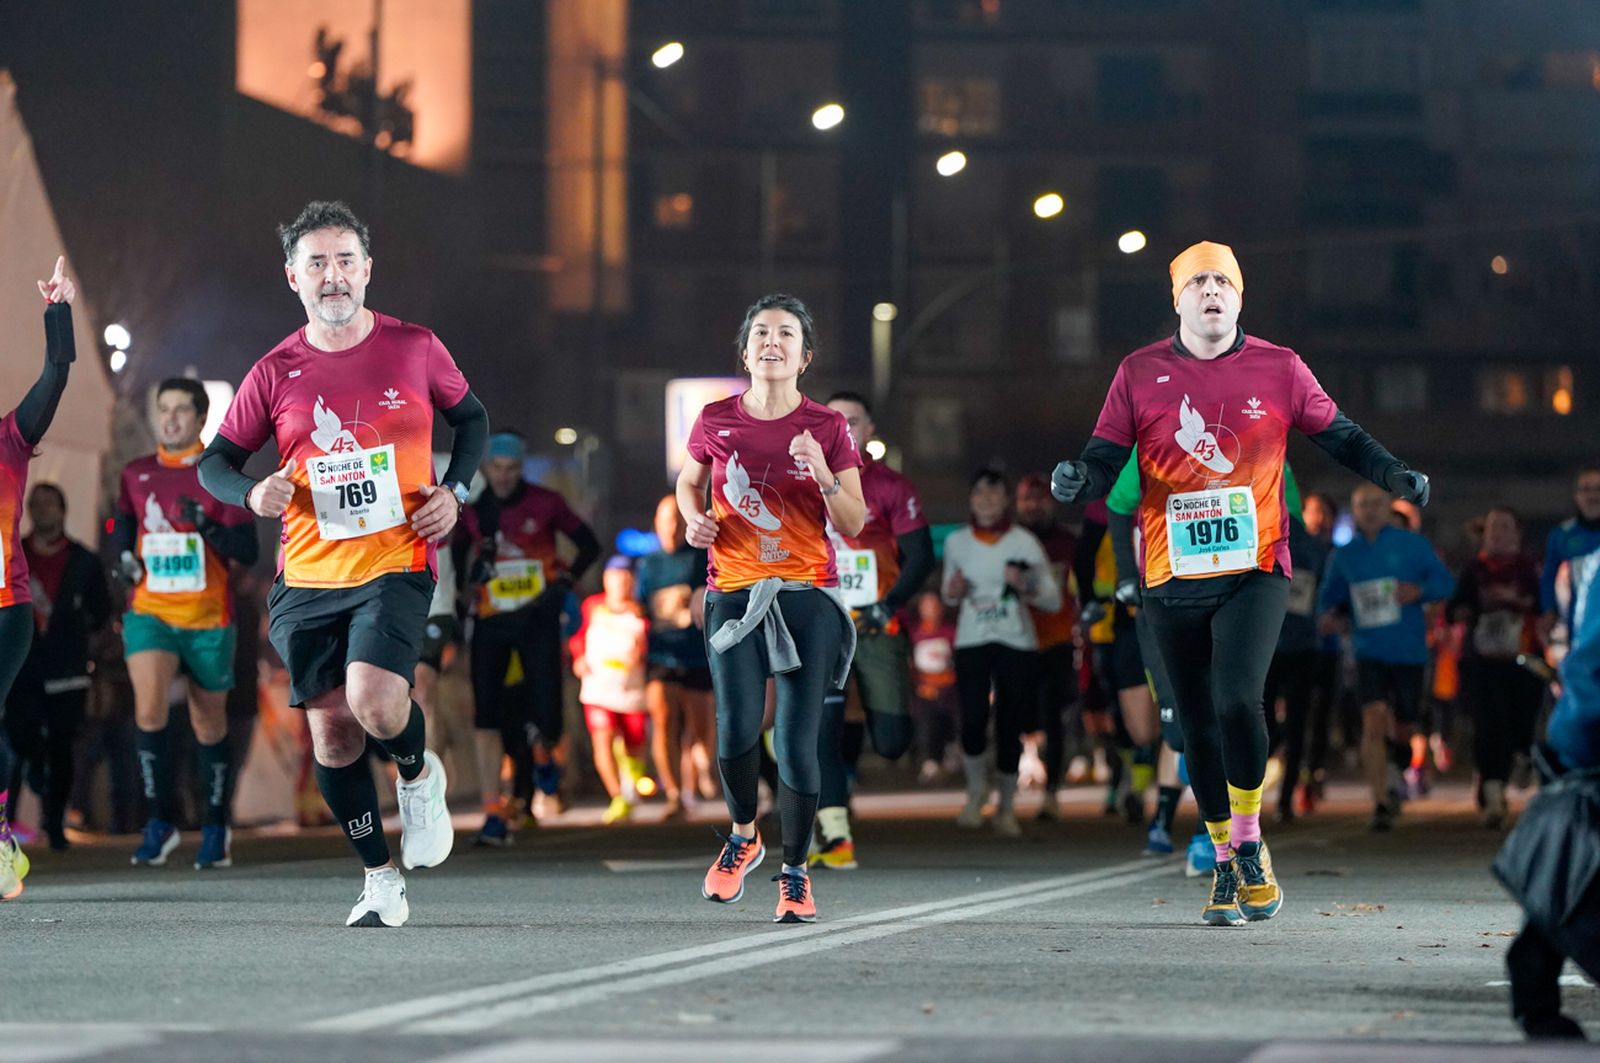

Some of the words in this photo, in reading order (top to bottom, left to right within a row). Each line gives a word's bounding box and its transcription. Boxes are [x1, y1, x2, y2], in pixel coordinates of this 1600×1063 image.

[1193, 439, 1216, 461] 43
[327, 463, 352, 473] NOCHE
[352, 460, 364, 470] DE
[320, 475, 336, 486] SAN
[335, 479, 378, 510] 769
[738, 494, 761, 518] 43
[1183, 500, 1209, 510] NOCHE
[1210, 498, 1222, 509] DE
[1175, 511, 1192, 522] SAN
[1185, 517, 1239, 547] 1976
[1198, 546, 1212, 554] José
